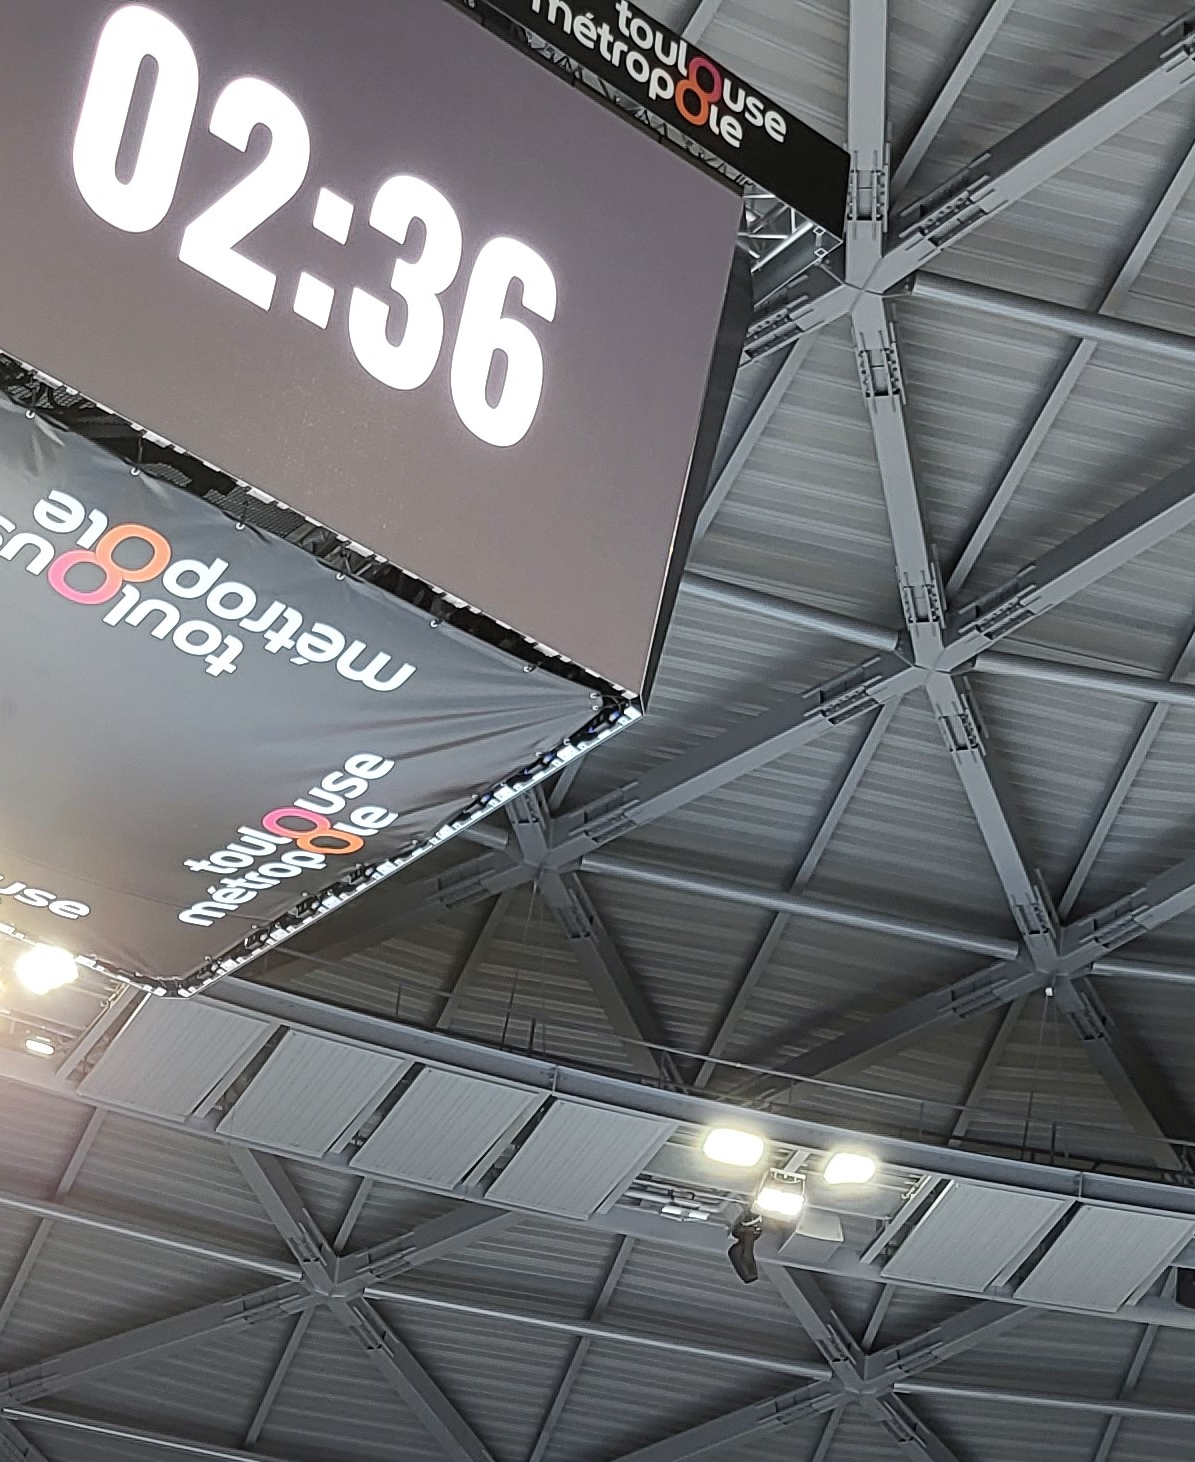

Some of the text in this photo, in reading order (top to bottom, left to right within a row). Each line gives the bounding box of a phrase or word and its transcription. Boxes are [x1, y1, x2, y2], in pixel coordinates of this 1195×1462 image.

[531, 0, 743, 148] métropole
[615, 0, 787, 143] toulouse
[72, 4, 558, 447] 02:36
[33, 489, 417, 692] métropole
[178, 805, 400, 928] métropole
[183, 753, 395, 877] toulouse
